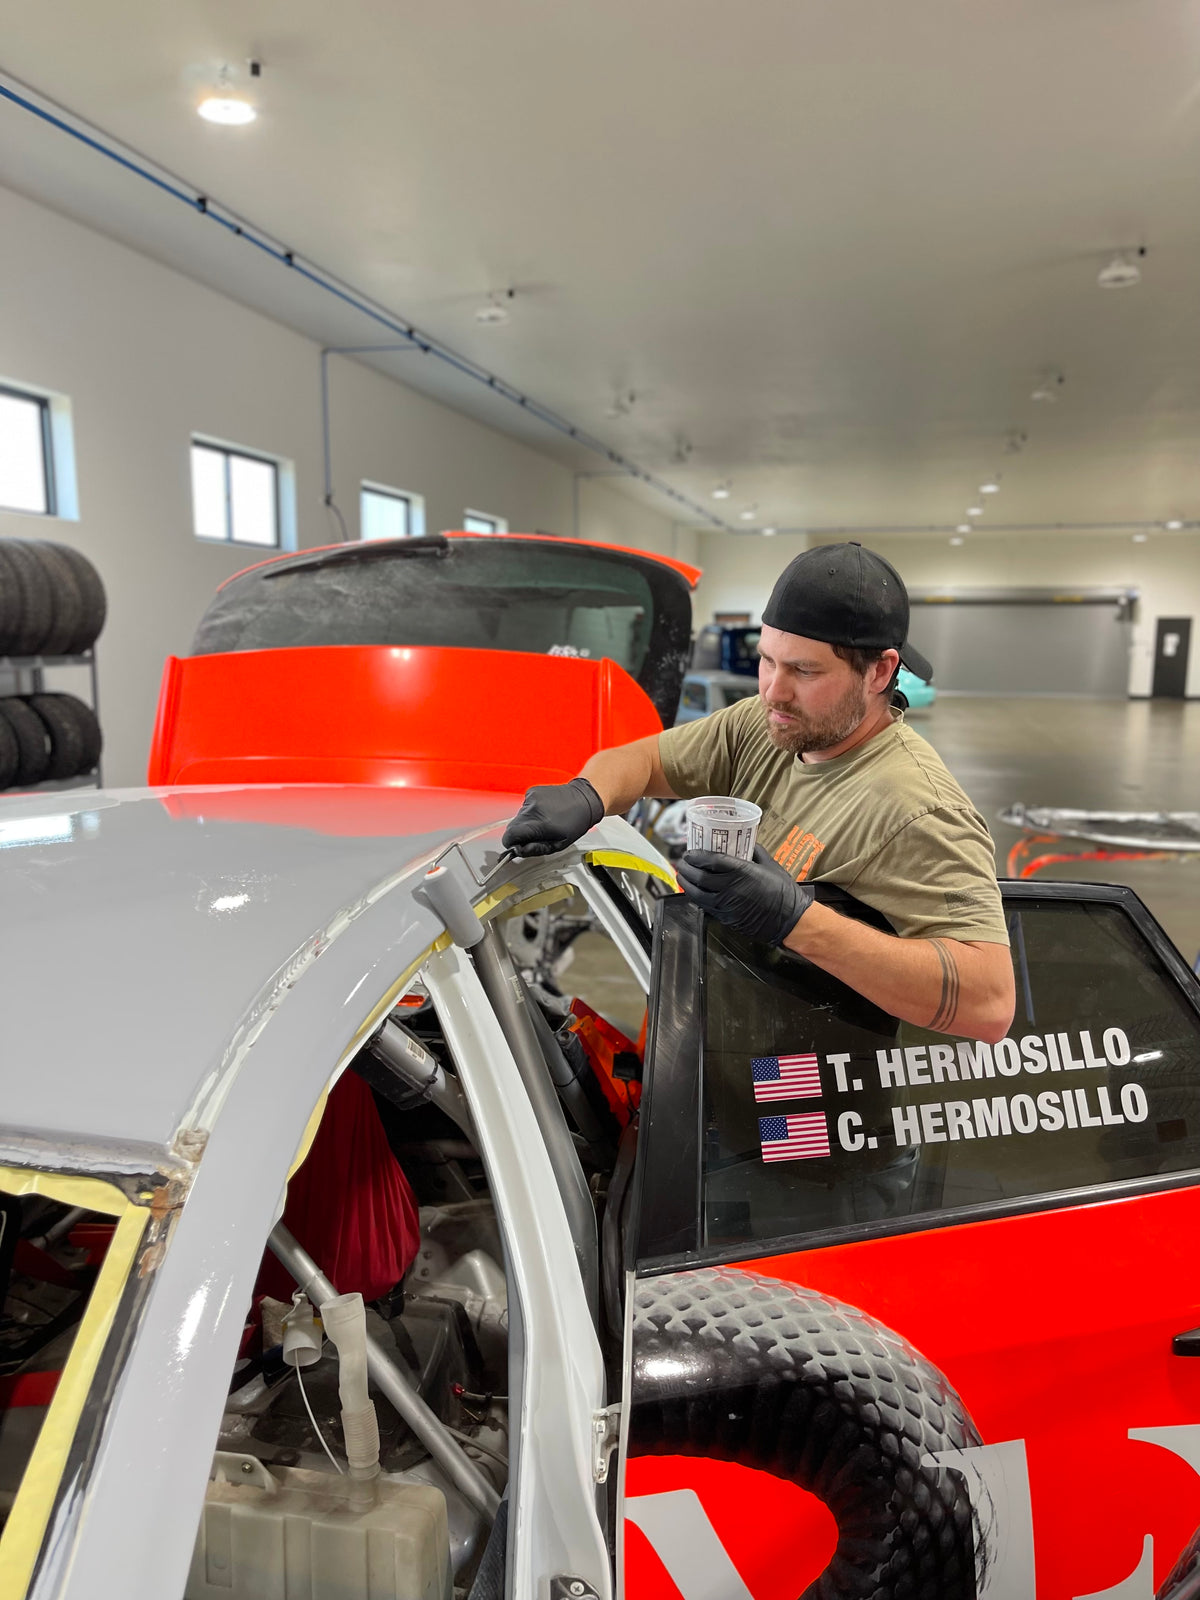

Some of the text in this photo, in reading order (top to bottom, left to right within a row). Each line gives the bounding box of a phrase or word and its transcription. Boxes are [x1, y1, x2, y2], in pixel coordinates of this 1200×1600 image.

[826, 1027, 1131, 1092] T. HERMOSILLO
[837, 1083, 1149, 1152] C. HERMOSILLO
